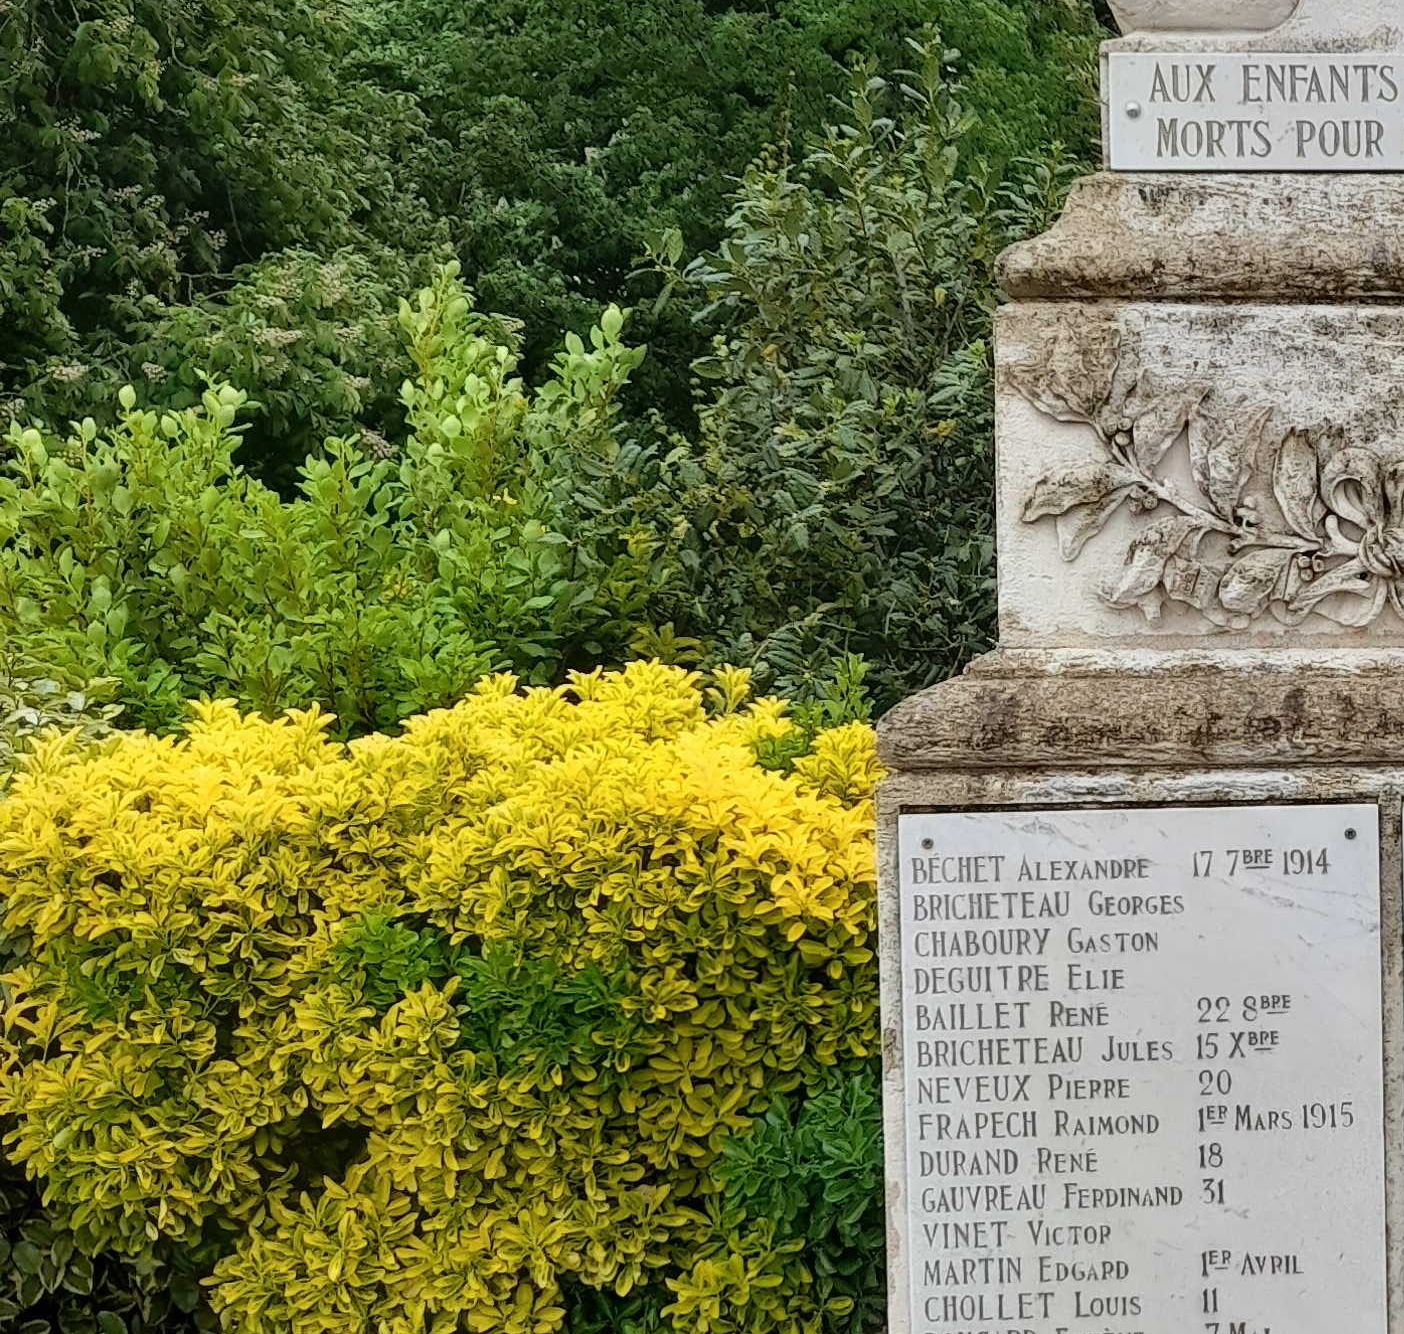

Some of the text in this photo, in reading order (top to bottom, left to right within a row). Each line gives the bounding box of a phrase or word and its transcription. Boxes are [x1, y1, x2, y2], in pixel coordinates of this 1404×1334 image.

[1149, 62, 1216, 102] AUX
[1242, 65, 1398, 105] ENFANTS
[1157, 118, 1271, 158] MORTS
[1296, 120, 1383, 158] POUR
[911, 848, 1331, 884] BÉCHET ALEXANDRE 17 1914
[914, 890, 1184, 921] BRICHETEAU GEORGES
[915, 927, 1158, 957] CHABOURY GASTON
[914, 964, 1125, 994] DEGUITRE ELIE
[916, 996, 1230, 1030] BAILLET RENÉ 22
[917, 1033, 1218, 1067] BRICHETEAU JULES 15
[918, 1069, 1232, 1104] NEVEUX PIERRE 20
[919, 1102, 1353, 1140] FRAPECH RAIMOND MARS 1915
[920, 1143, 1223, 1177] DURAND RENÉ 18
[922, 1178, 1225, 1213] GAUVREAU FERDINAND 31
[923, 1220, 1111, 1249] VINET VICTOR
[924, 1252, 1304, 1286] MARTIN EDGARD AVRIL
[925, 1291, 1141, 1322] CHOLLET LOUIS
